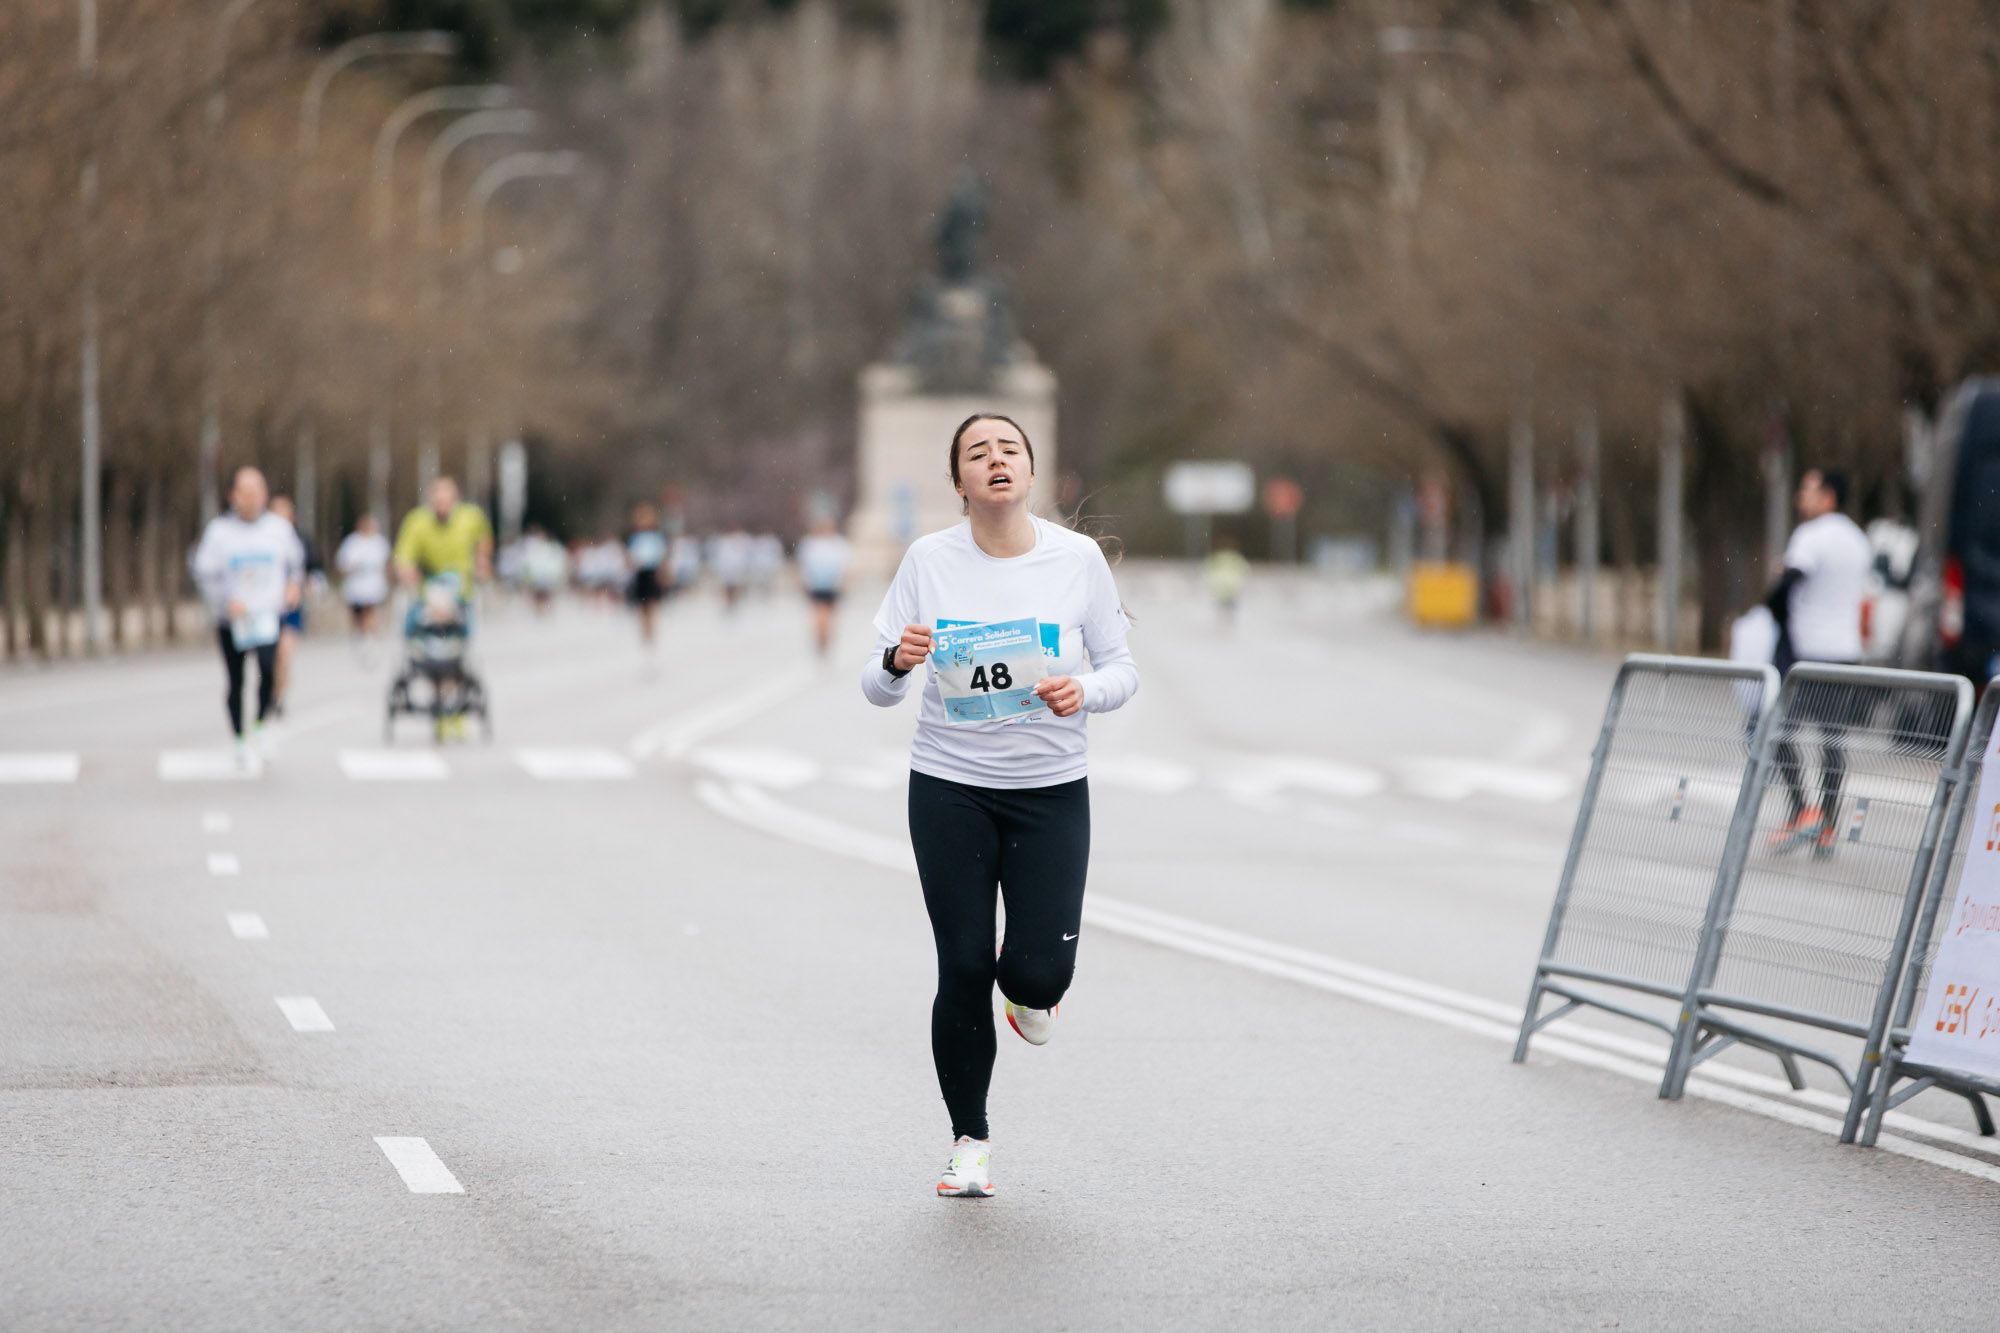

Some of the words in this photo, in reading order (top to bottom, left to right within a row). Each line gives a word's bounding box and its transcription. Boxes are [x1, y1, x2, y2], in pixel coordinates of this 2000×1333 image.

[951, 635, 983, 645] Carrera
[985, 628, 1021, 639] Solidaria
[970, 663, 1012, 692] 48
